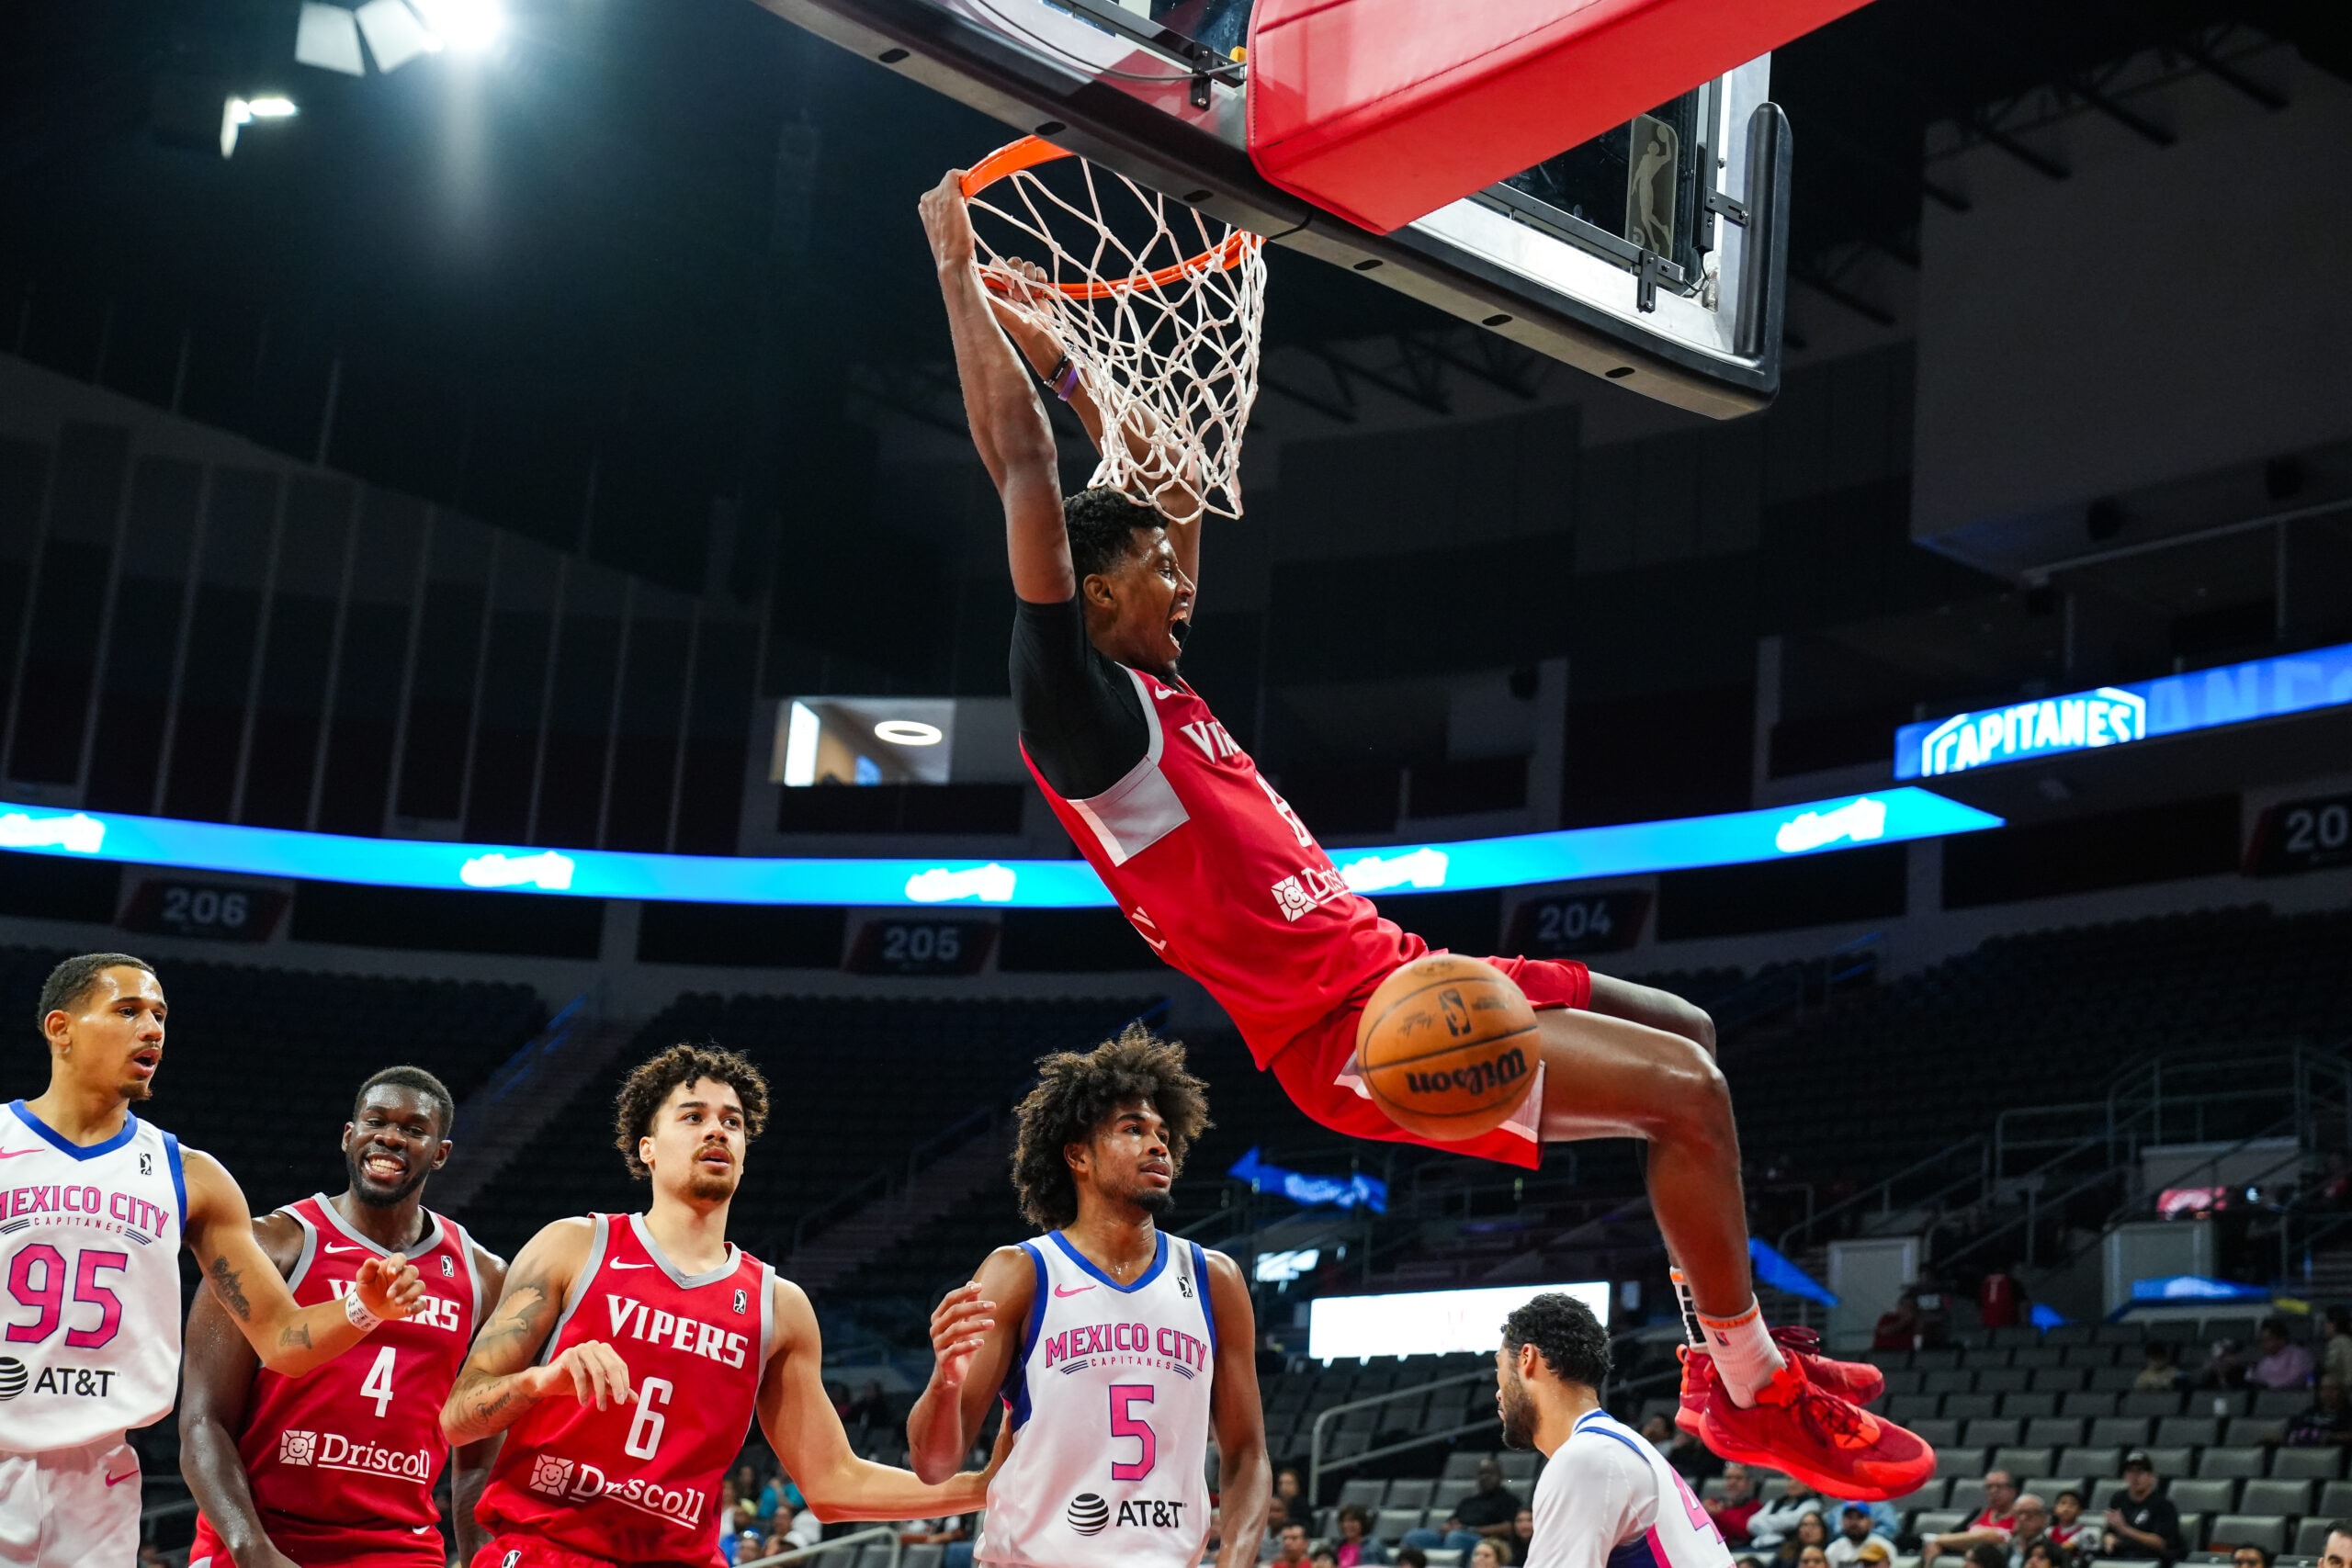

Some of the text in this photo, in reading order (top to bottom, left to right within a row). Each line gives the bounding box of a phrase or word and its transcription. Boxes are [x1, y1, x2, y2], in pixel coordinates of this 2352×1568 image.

[1934, 699, 2132, 775] CAPITANES
[163, 887, 247, 927] 206
[1538, 900, 1611, 939] 204
[883, 926, 959, 961] 205
[1406, 1047, 1528, 1095] Wilson
[34, 1216, 123, 1234] CAPITANES
[109, 1192, 169, 1238] CITY
[6, 1243, 128, 1349] 95
[605, 1294, 749, 1370] VIPERS
[1046, 1323, 1207, 1371] MEXICO CITY
[33, 1367, 116, 1397] AT&T
[360, 1346, 397, 1417] 4
[1091, 1356, 1171, 1370] CAPITANES
[625, 1376, 673, 1461] 6
[1109, 1384, 1156, 1481] 5
[319, 1433, 430, 1479] Driscoll
[1115, 1500, 1182, 1528] AT&T
